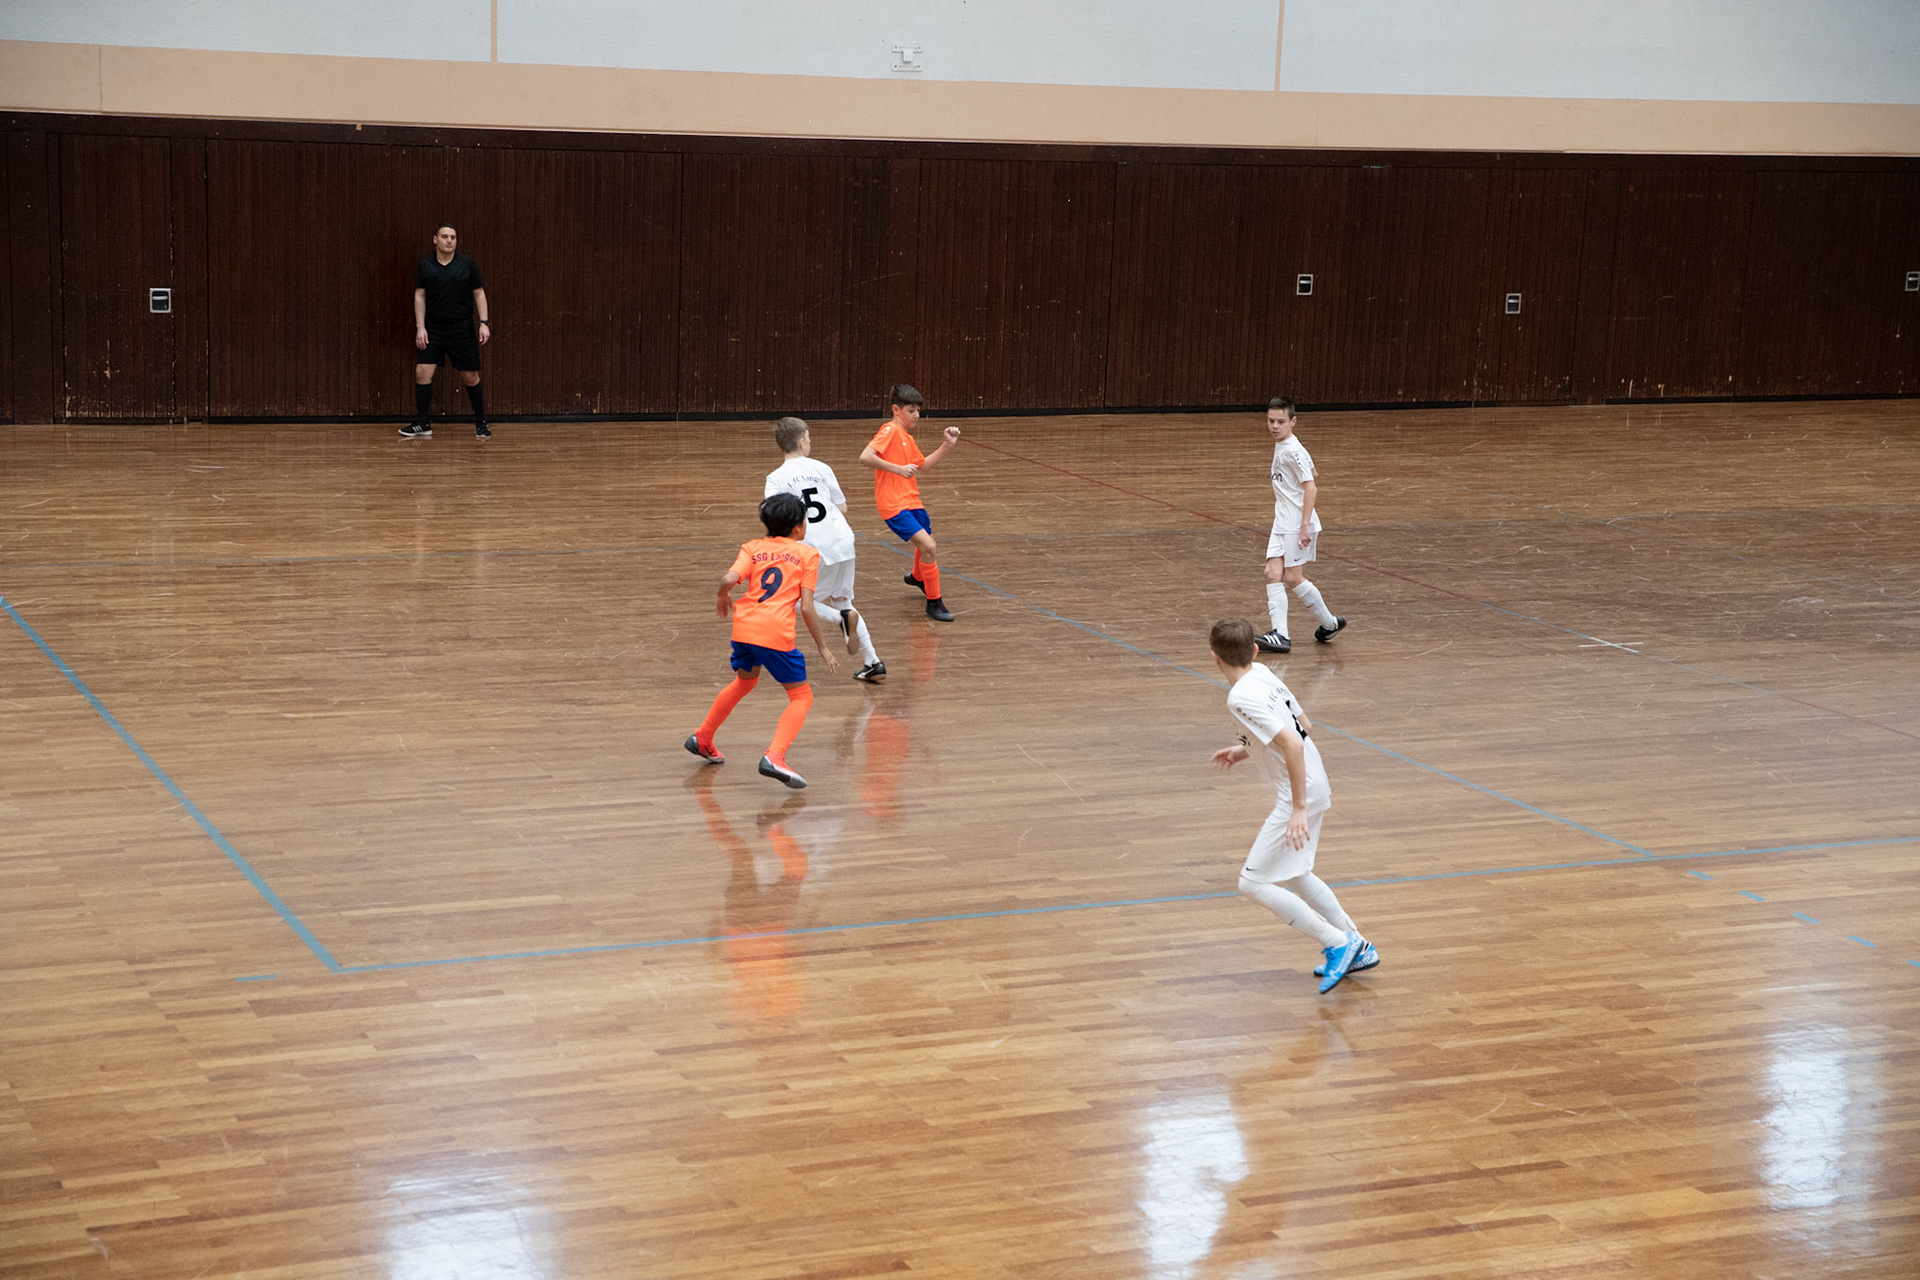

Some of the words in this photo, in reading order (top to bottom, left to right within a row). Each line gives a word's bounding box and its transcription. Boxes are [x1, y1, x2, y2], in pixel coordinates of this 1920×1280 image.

[801, 487, 827, 524] 5
[752, 553, 768, 565] SSG
[758, 566, 783, 603] 9
